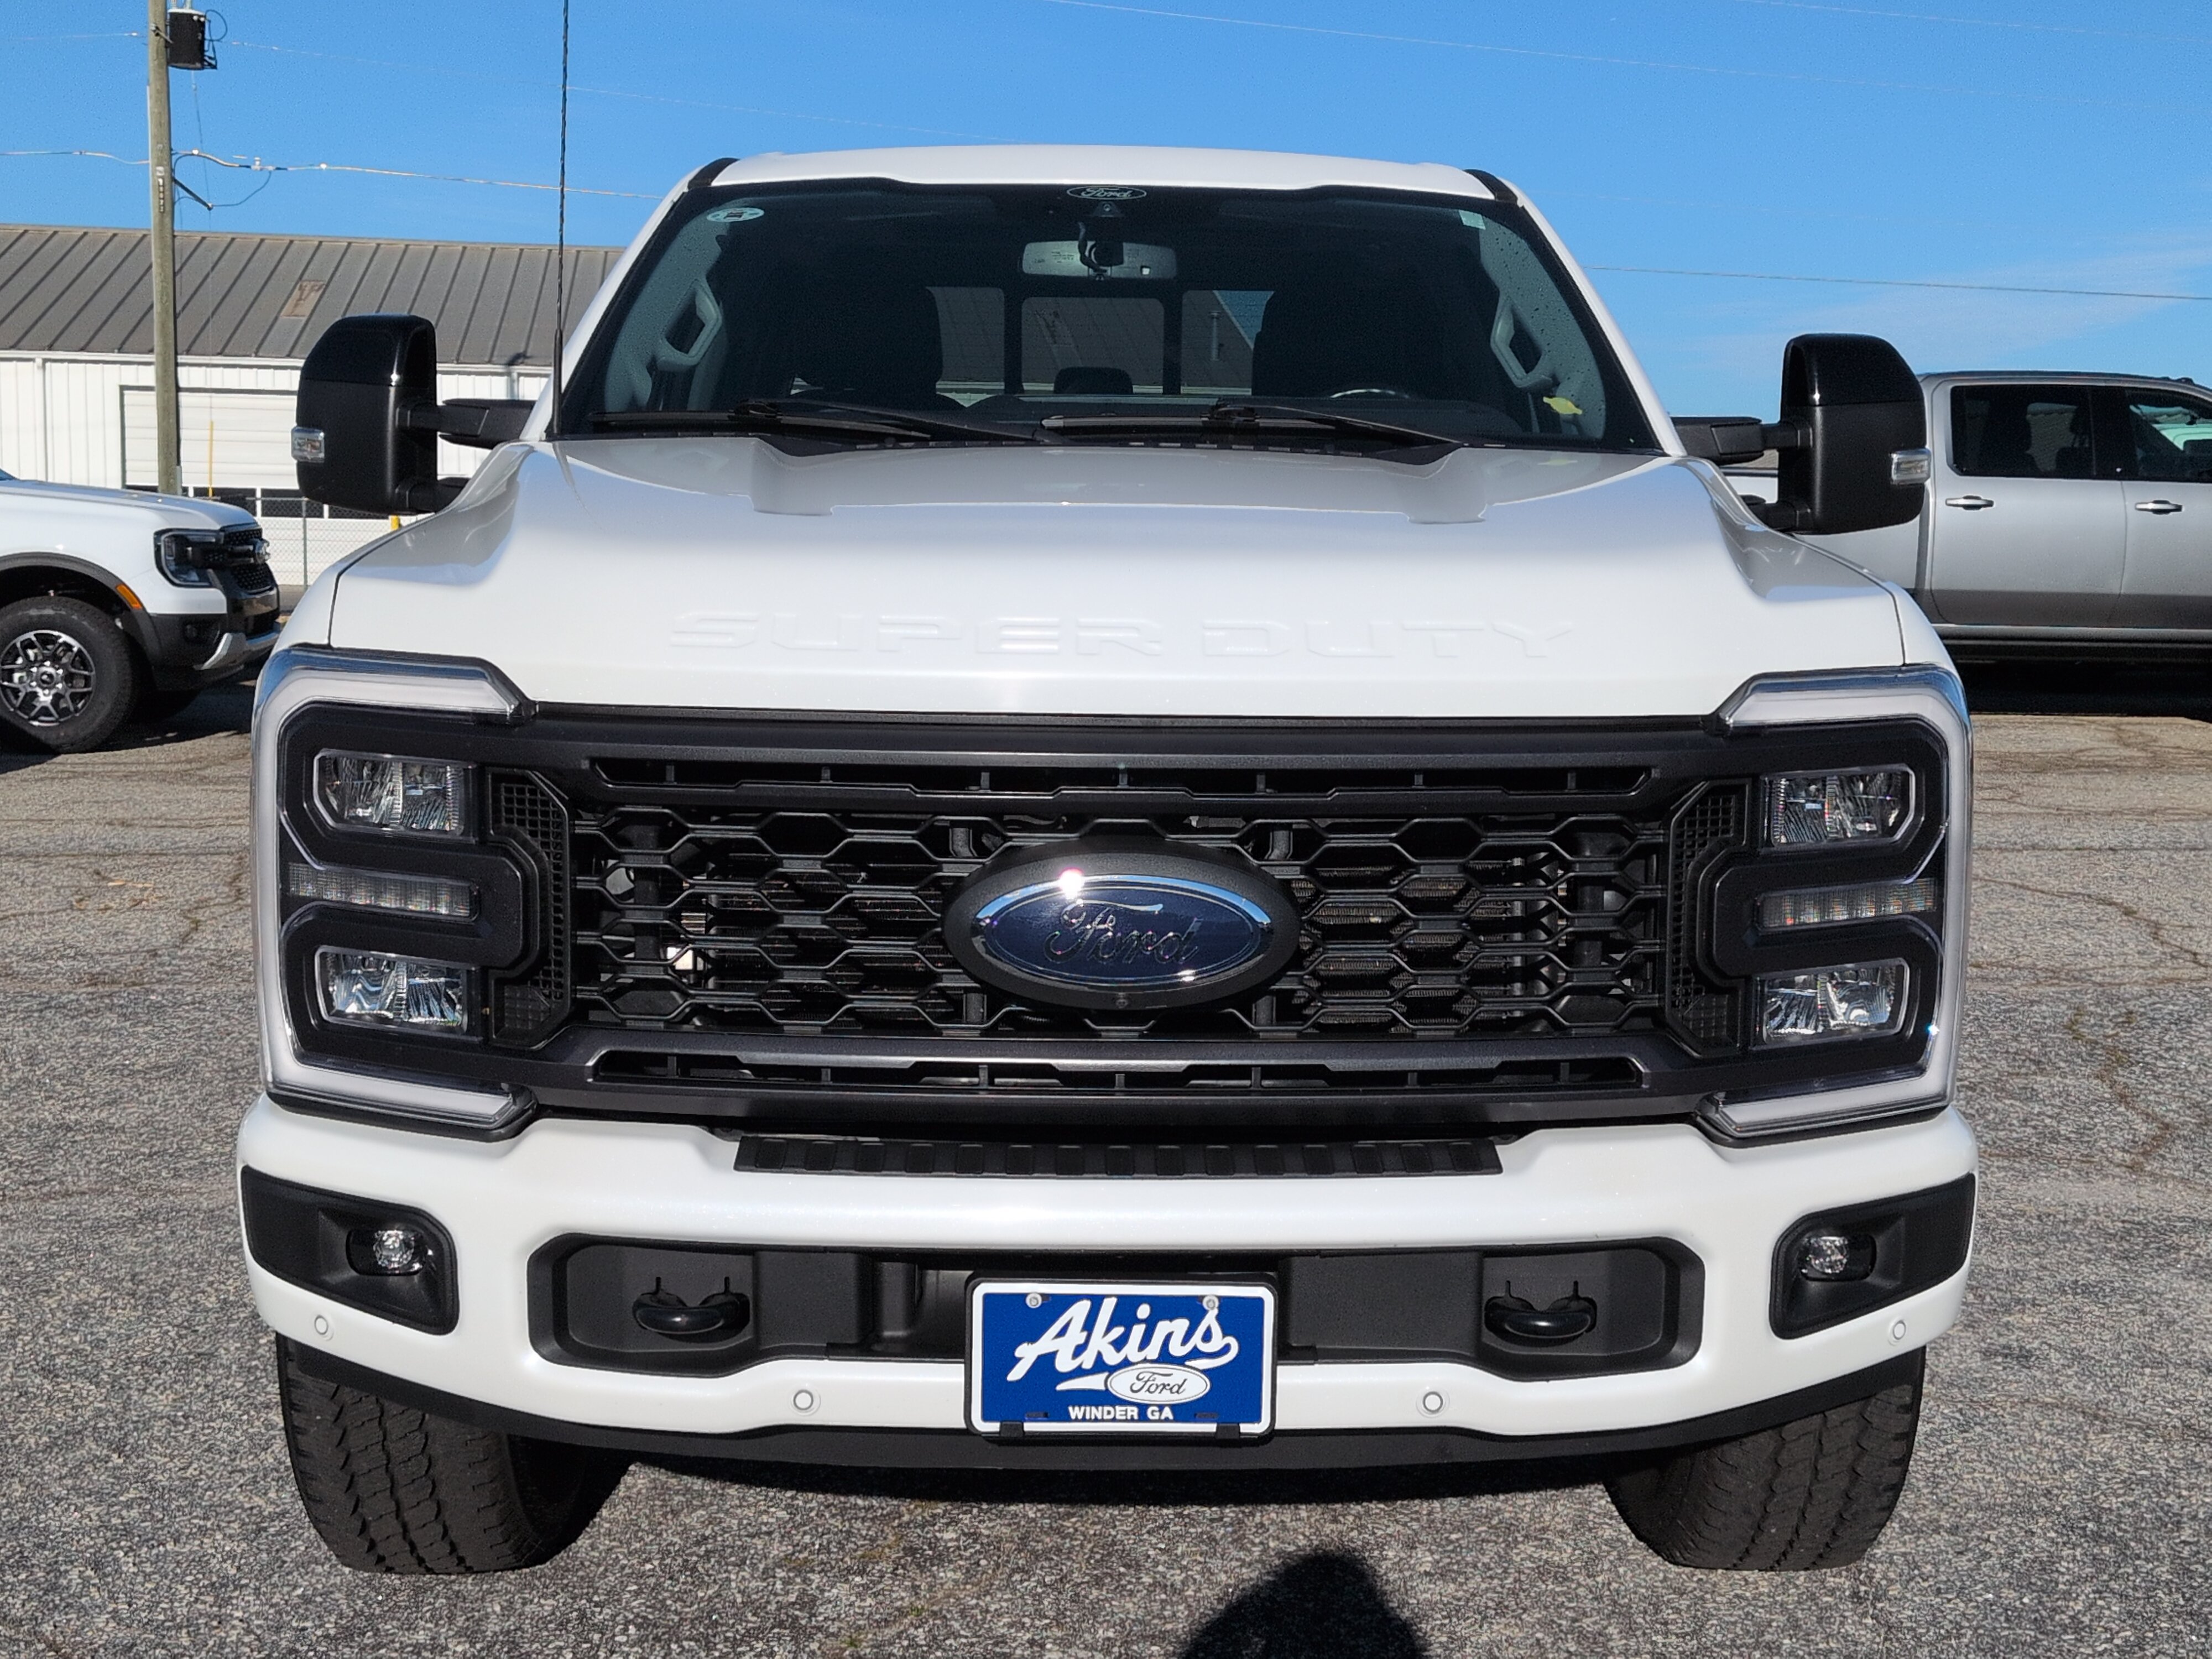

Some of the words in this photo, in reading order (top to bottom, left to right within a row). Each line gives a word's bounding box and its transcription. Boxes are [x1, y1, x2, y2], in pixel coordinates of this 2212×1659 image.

[1081, 187, 1133, 197] Ford
[671, 611, 1164, 656] SUPER
[1202, 618, 1574, 658] DUTY
[1044, 899, 1200, 964] Ford
[1006, 1296, 1239, 1381] Akins
[1129, 1370, 1188, 1395] Ford
[1068, 1405, 1138, 1420] WINDER
[1147, 1406, 1173, 1420] GA
